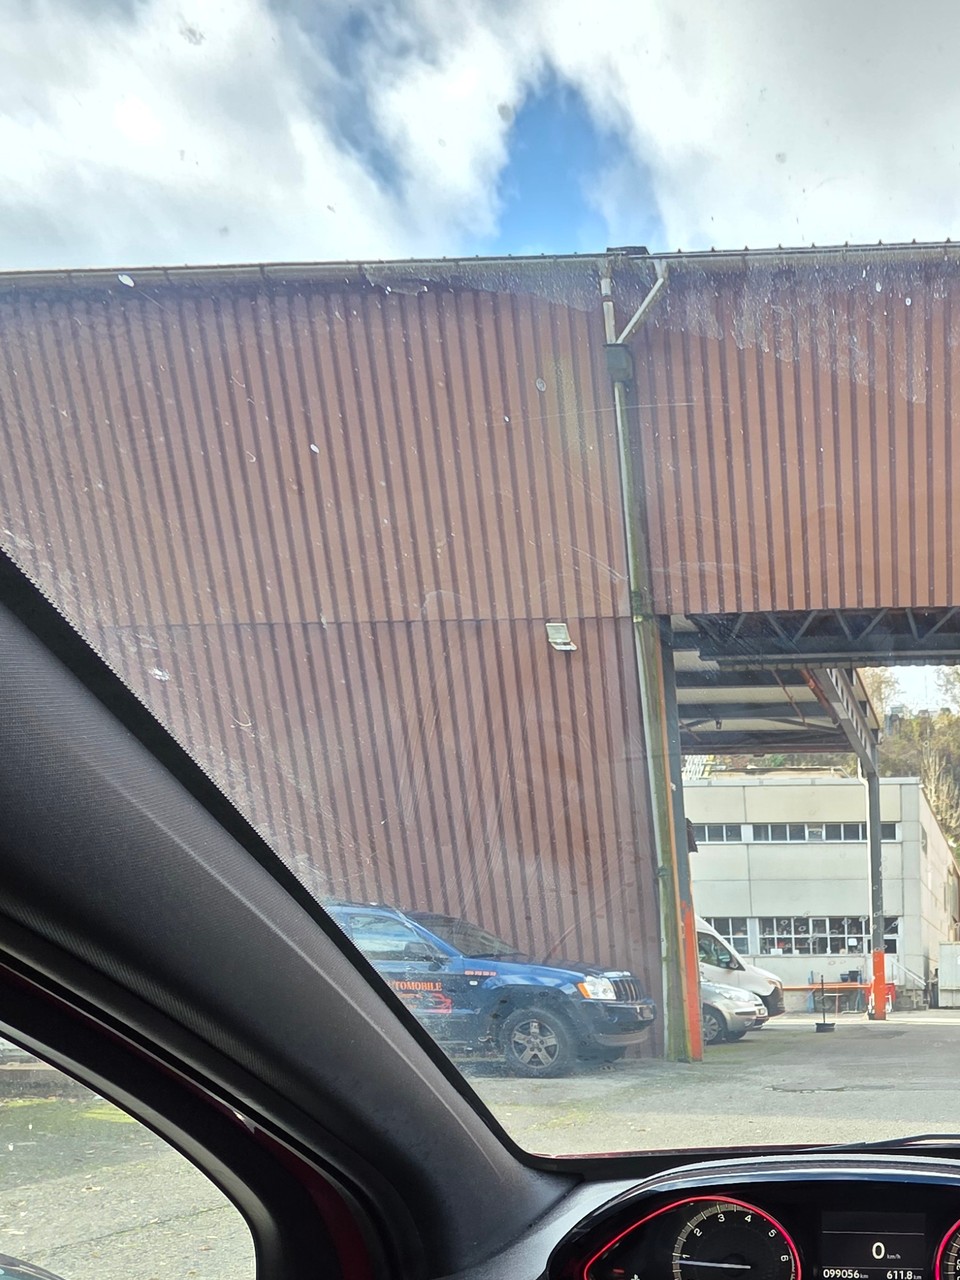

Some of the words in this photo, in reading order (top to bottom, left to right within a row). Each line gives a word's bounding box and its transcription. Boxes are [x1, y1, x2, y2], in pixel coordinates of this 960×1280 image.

[694, 1228, 702, 1236] 2
[718, 1214, 725, 1222] 3
[768, 1229, 777, 1237] 5
[872, 1241, 885, 1259] 0
[823, 1269, 860, 1279] 099056
[886, 1271, 913, 1280] 611.8
